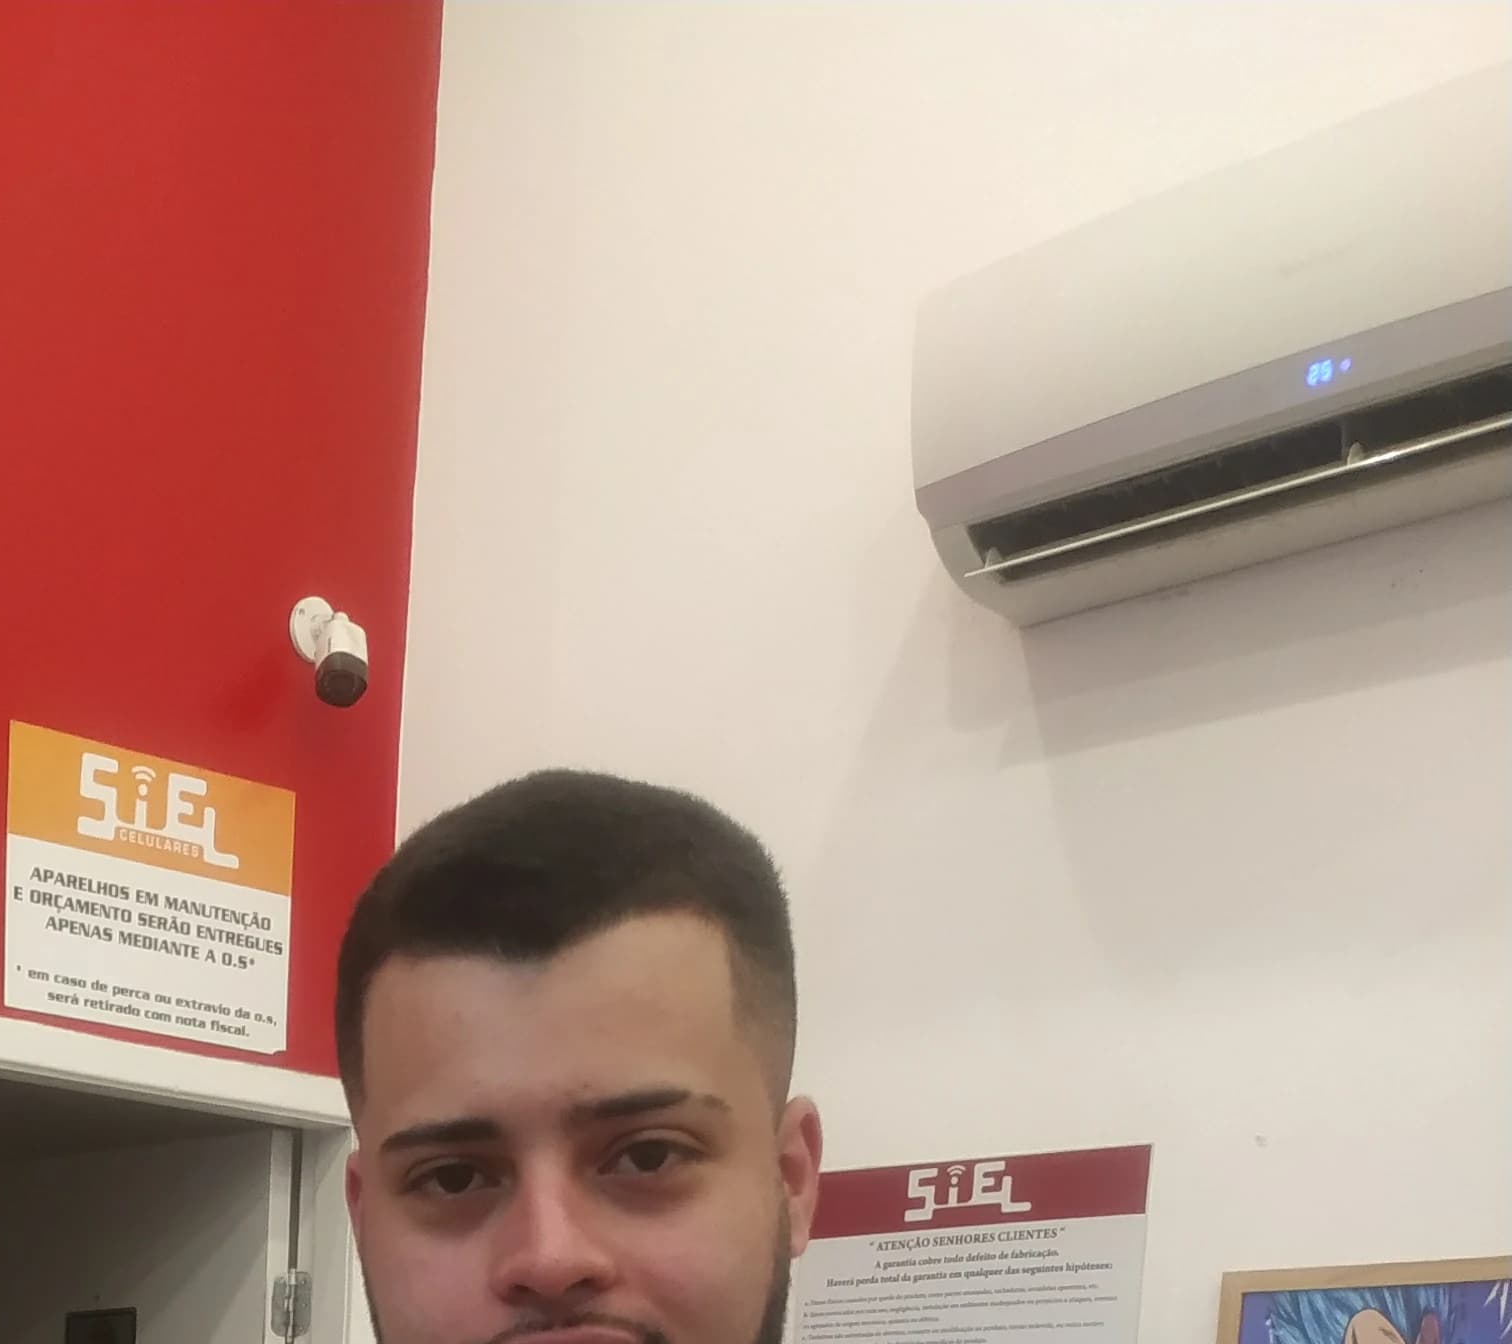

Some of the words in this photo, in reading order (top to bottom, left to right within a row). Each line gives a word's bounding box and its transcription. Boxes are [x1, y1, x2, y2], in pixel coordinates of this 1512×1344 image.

[119, 829, 200, 858] CELULARES
[13, 885, 24, 901] E
[29, 888, 133, 924] ORÇAMENTO
[138, 912, 191, 936] SERÃO
[196, 924, 284, 956] ENTREGUES
[30, 866, 130, 901] APARELHOS
[135, 889, 159, 907] EM
[164, 895, 271, 932] MANUTENÇÃO
[45, 916, 113, 943] APENAS
[118, 930, 200, 961] MEDIANTE
[204, 949, 217, 964] A
[27, 968, 50, 982] em
[53, 973, 87, 989] caso
[91, 979, 109, 993] de
[112, 984, 151, 1002] perca
[154, 993, 172, 1005] ou
[175, 997, 232, 1017] extravio
[234, 1007, 251, 1021] da
[47, 991, 80, 1006] será
[83, 997, 141, 1018] retirado
[144, 1009, 172, 1024] com
[175, 1015, 207, 1031] nota
[210, 1019, 251, 1038] fiscal.
[876, 1236, 931, 1252] ATENÇÃO
[932, 1231, 996, 1248] SENHORES
[997, 1227, 1058, 1243] CLIENTES
[998, 1250, 1009, 1260] de
[880, 1272, 900, 1284] total
[900, 1271, 912, 1283] da
